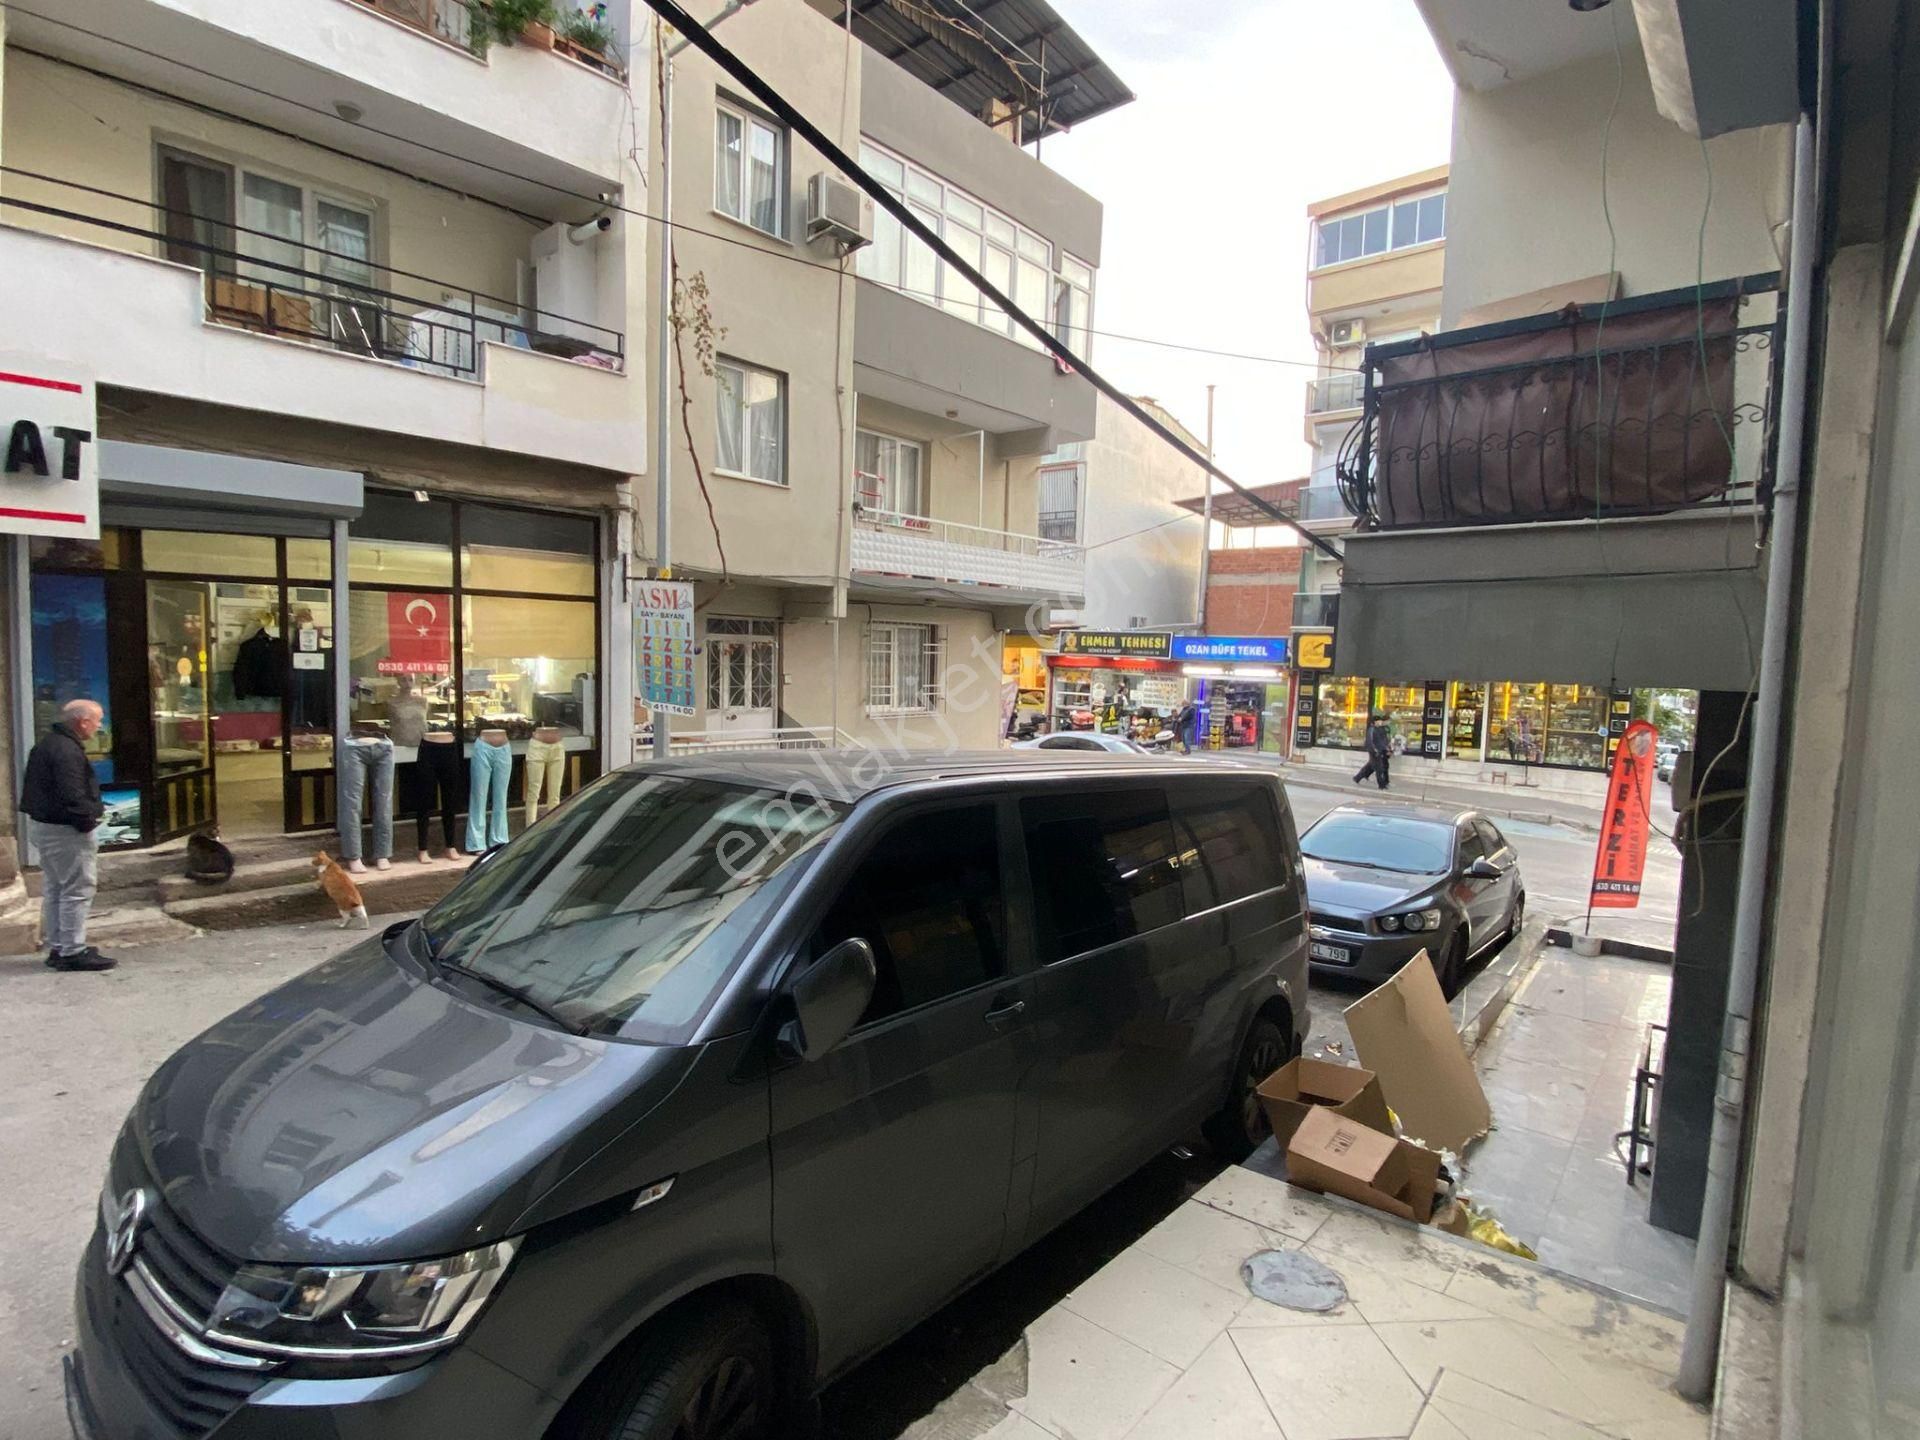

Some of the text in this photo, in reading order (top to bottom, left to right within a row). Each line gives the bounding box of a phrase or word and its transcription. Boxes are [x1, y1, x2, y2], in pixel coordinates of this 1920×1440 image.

[5, 419, 91, 481] AT
[637, 587, 679, 611] ASM
[1185, 643, 1268, 656] OZAN BÜFE TEKEL
[407, 663, 420, 671] 411
[653, 703, 669, 711] 411
